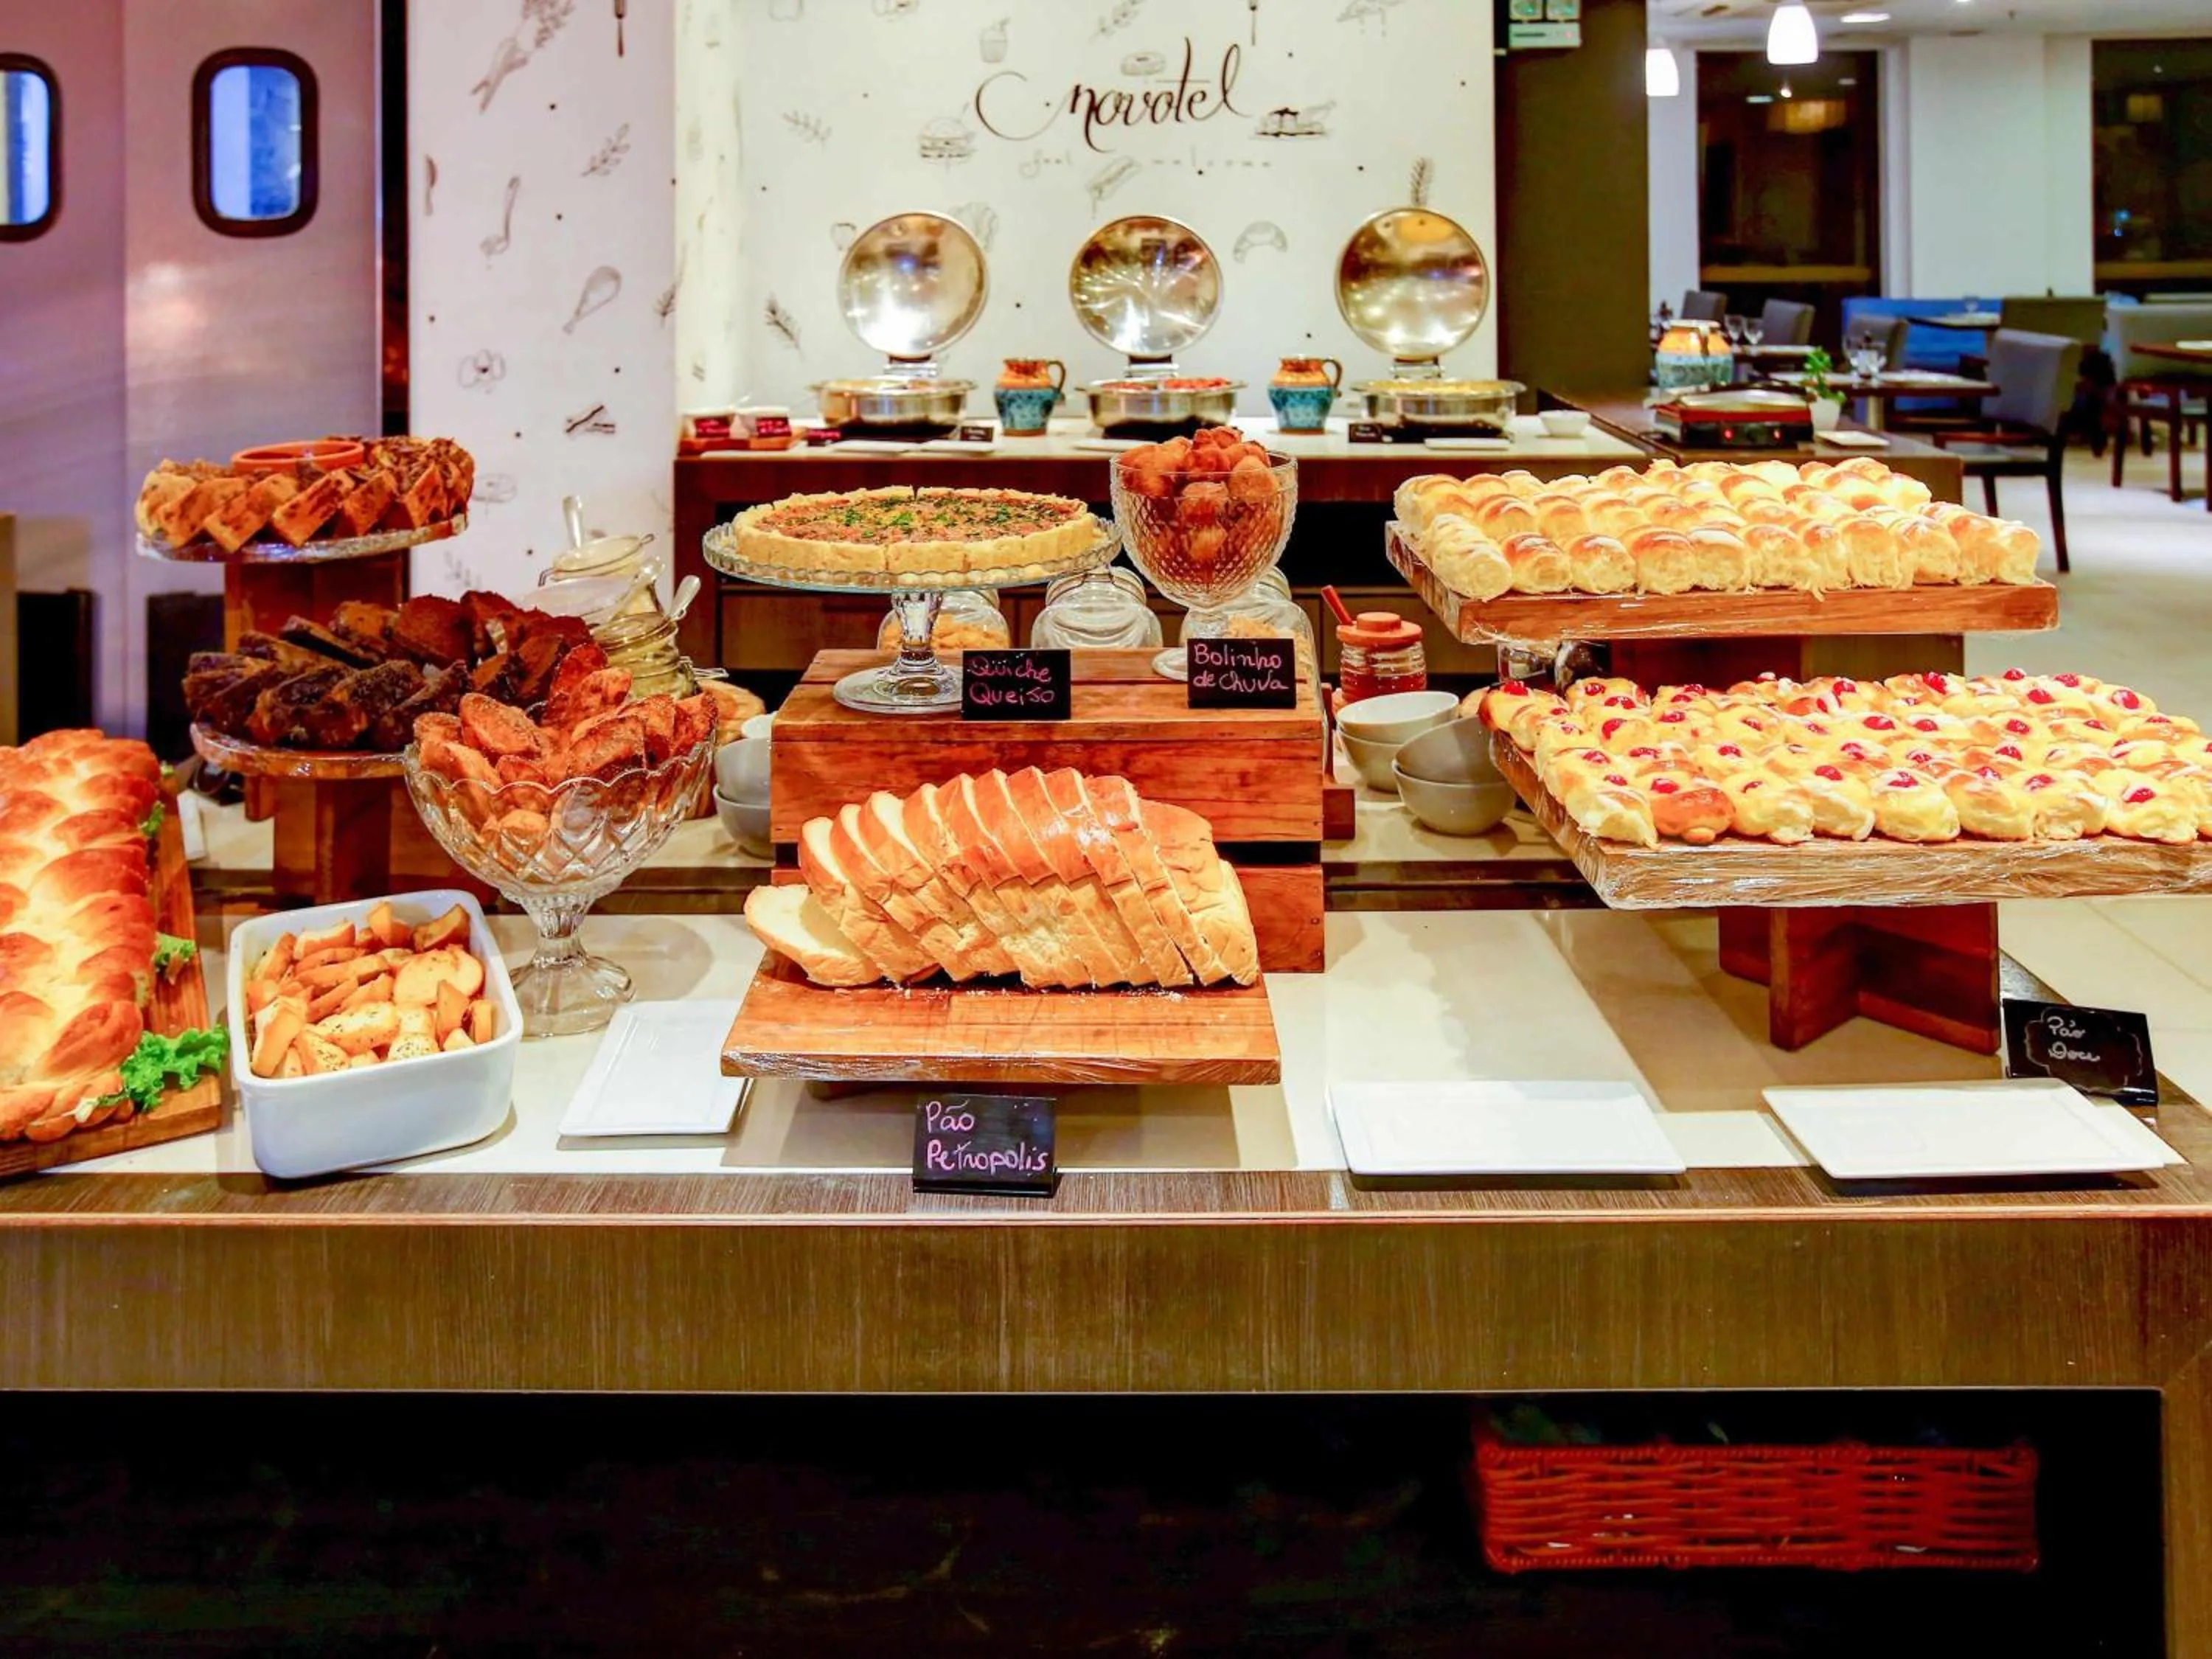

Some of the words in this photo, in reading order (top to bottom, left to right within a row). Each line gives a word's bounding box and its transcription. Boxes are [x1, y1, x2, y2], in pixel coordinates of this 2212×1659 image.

[975, 37, 1252, 152] novotel
[1194, 643, 1282, 670] Bolinho
[1193, 669, 1217, 687] de
[926, 1099, 974, 1133] Pão
